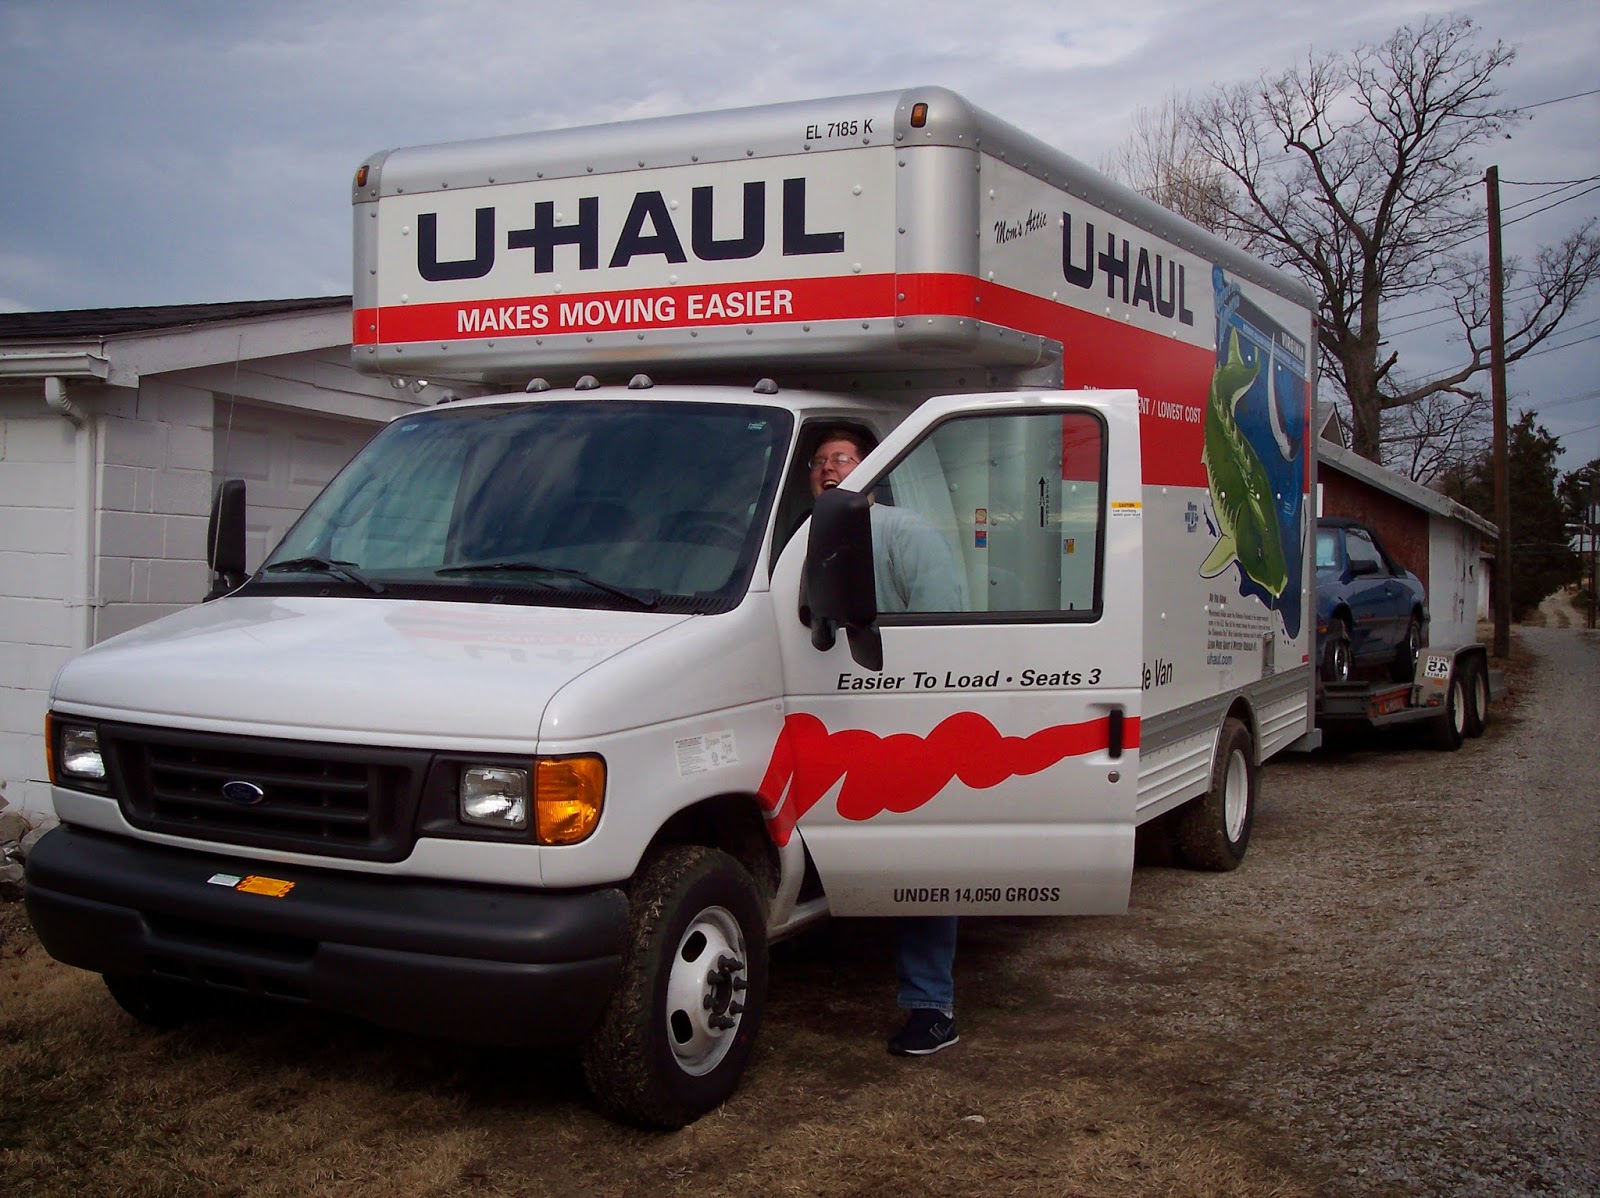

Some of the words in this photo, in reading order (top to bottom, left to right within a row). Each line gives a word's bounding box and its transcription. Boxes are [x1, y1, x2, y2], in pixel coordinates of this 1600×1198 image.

[806, 125, 822, 140] EL
[827, 120, 858, 138] 7185
[863, 118, 873, 134] K
[994, 220, 1023, 244] Mom's
[1025, 208, 1048, 236] Attic
[457, 304, 549, 333] MAKES
[559, 296, 676, 327] MOVING
[687, 289, 793, 320] EASIER
[1157, 400, 1184, 422] LOWEST
[1185, 405, 1202, 424] COST
[1207, 651, 1233, 666] uhaul.com
[836, 673, 905, 690] Easier
[912, 672, 938, 689] To
[944, 670, 999, 687] Load
[1020, 669, 1082, 687] Seats
[1088, 668, 1102, 685] 3
[1155, 658, 1173, 687] Van
[893, 888, 951, 904] UNDER
[954, 887, 1001, 905] 14,050
[1005, 887, 1061, 903] GROSS
